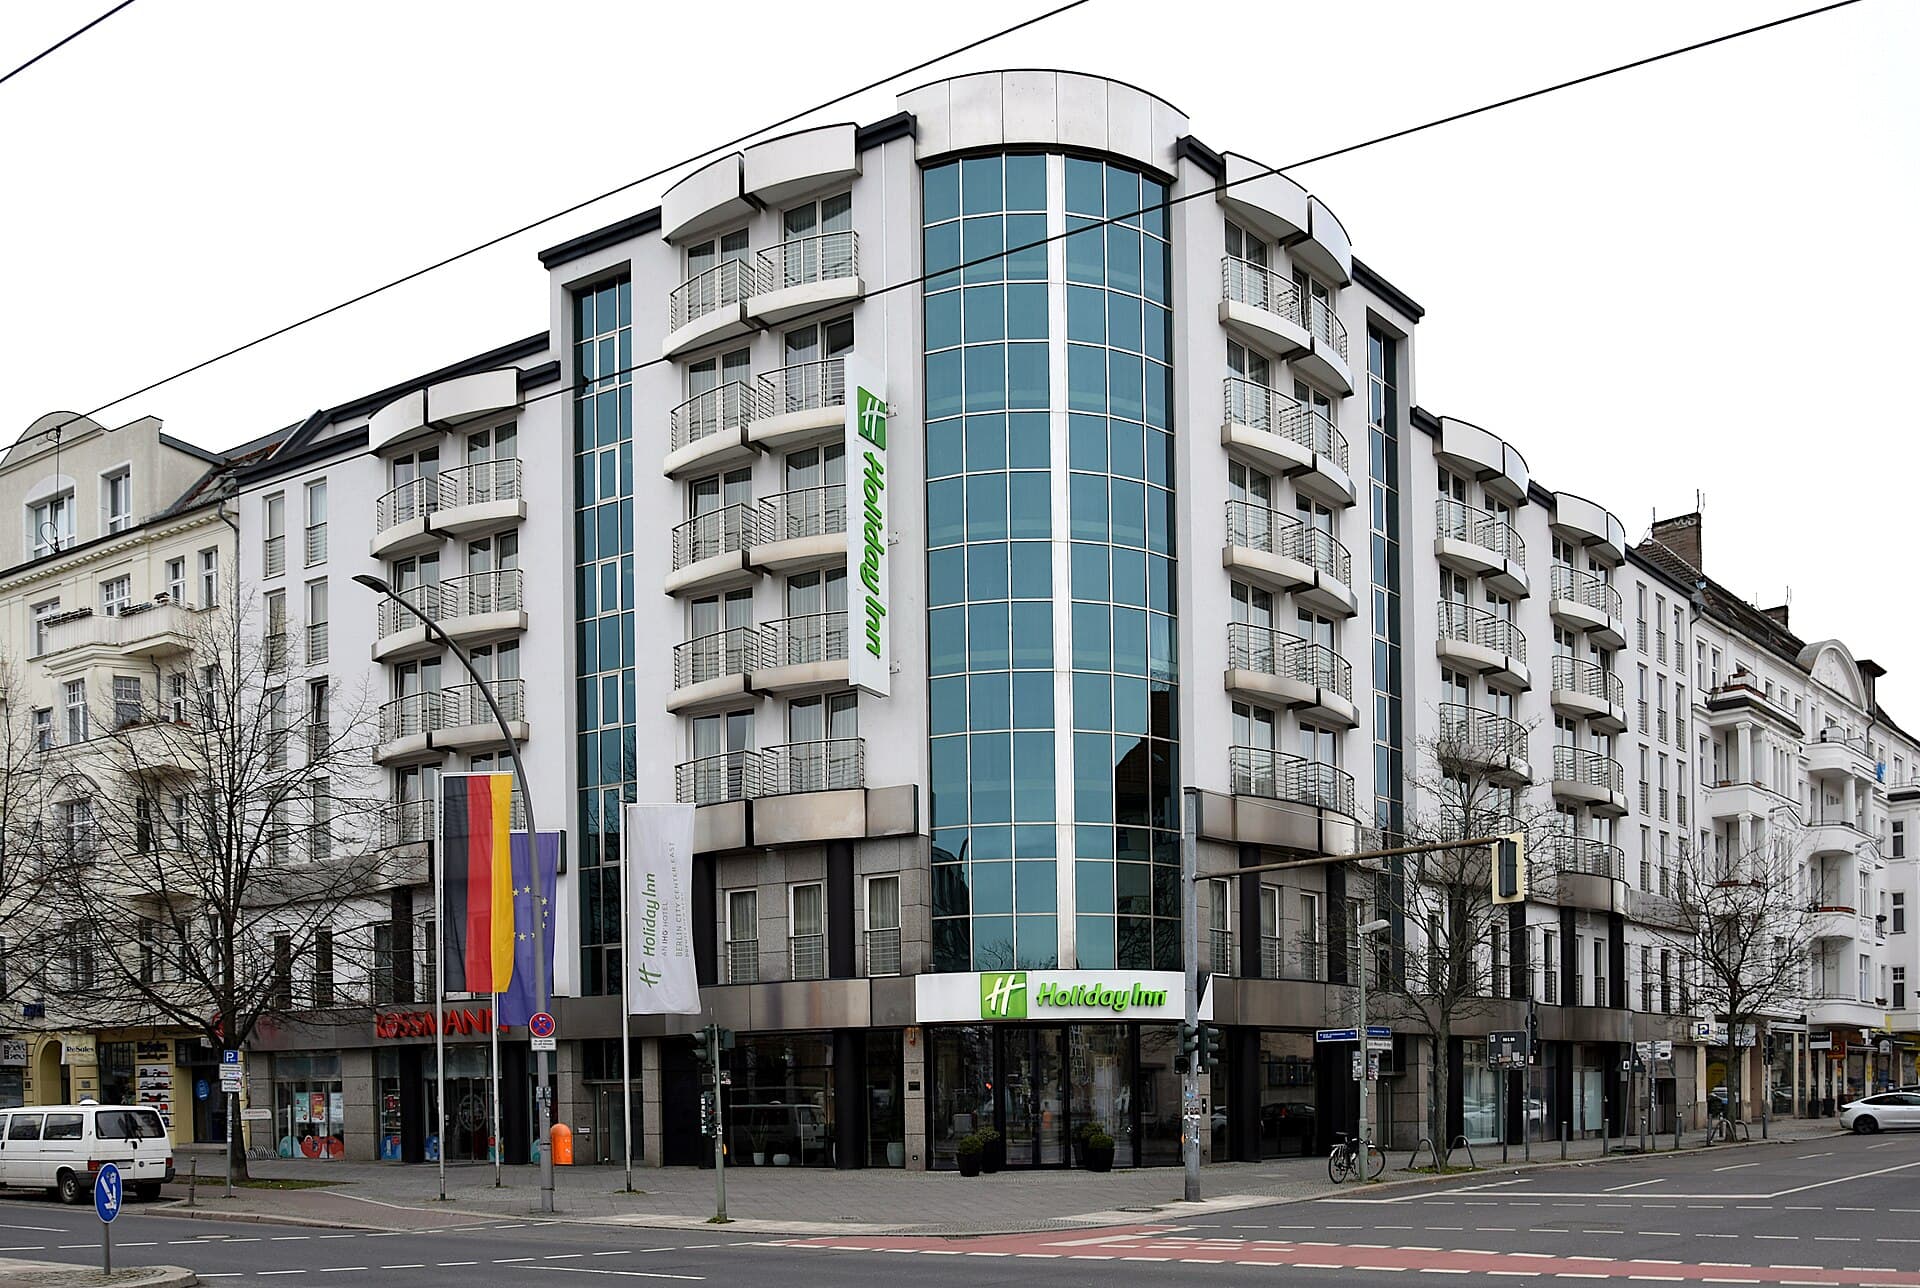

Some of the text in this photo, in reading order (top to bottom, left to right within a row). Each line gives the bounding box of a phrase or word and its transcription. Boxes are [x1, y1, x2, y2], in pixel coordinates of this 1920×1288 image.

[860, 451, 887, 660] Holiday Inn
[641, 872, 661, 958] Holiday Inn
[662, 945, 667, 957] AN
[675, 925, 684, 957] BERLIN
[1036, 981, 1168, 1013] Holiday Inn
[226, 1052, 234, 1062] P
